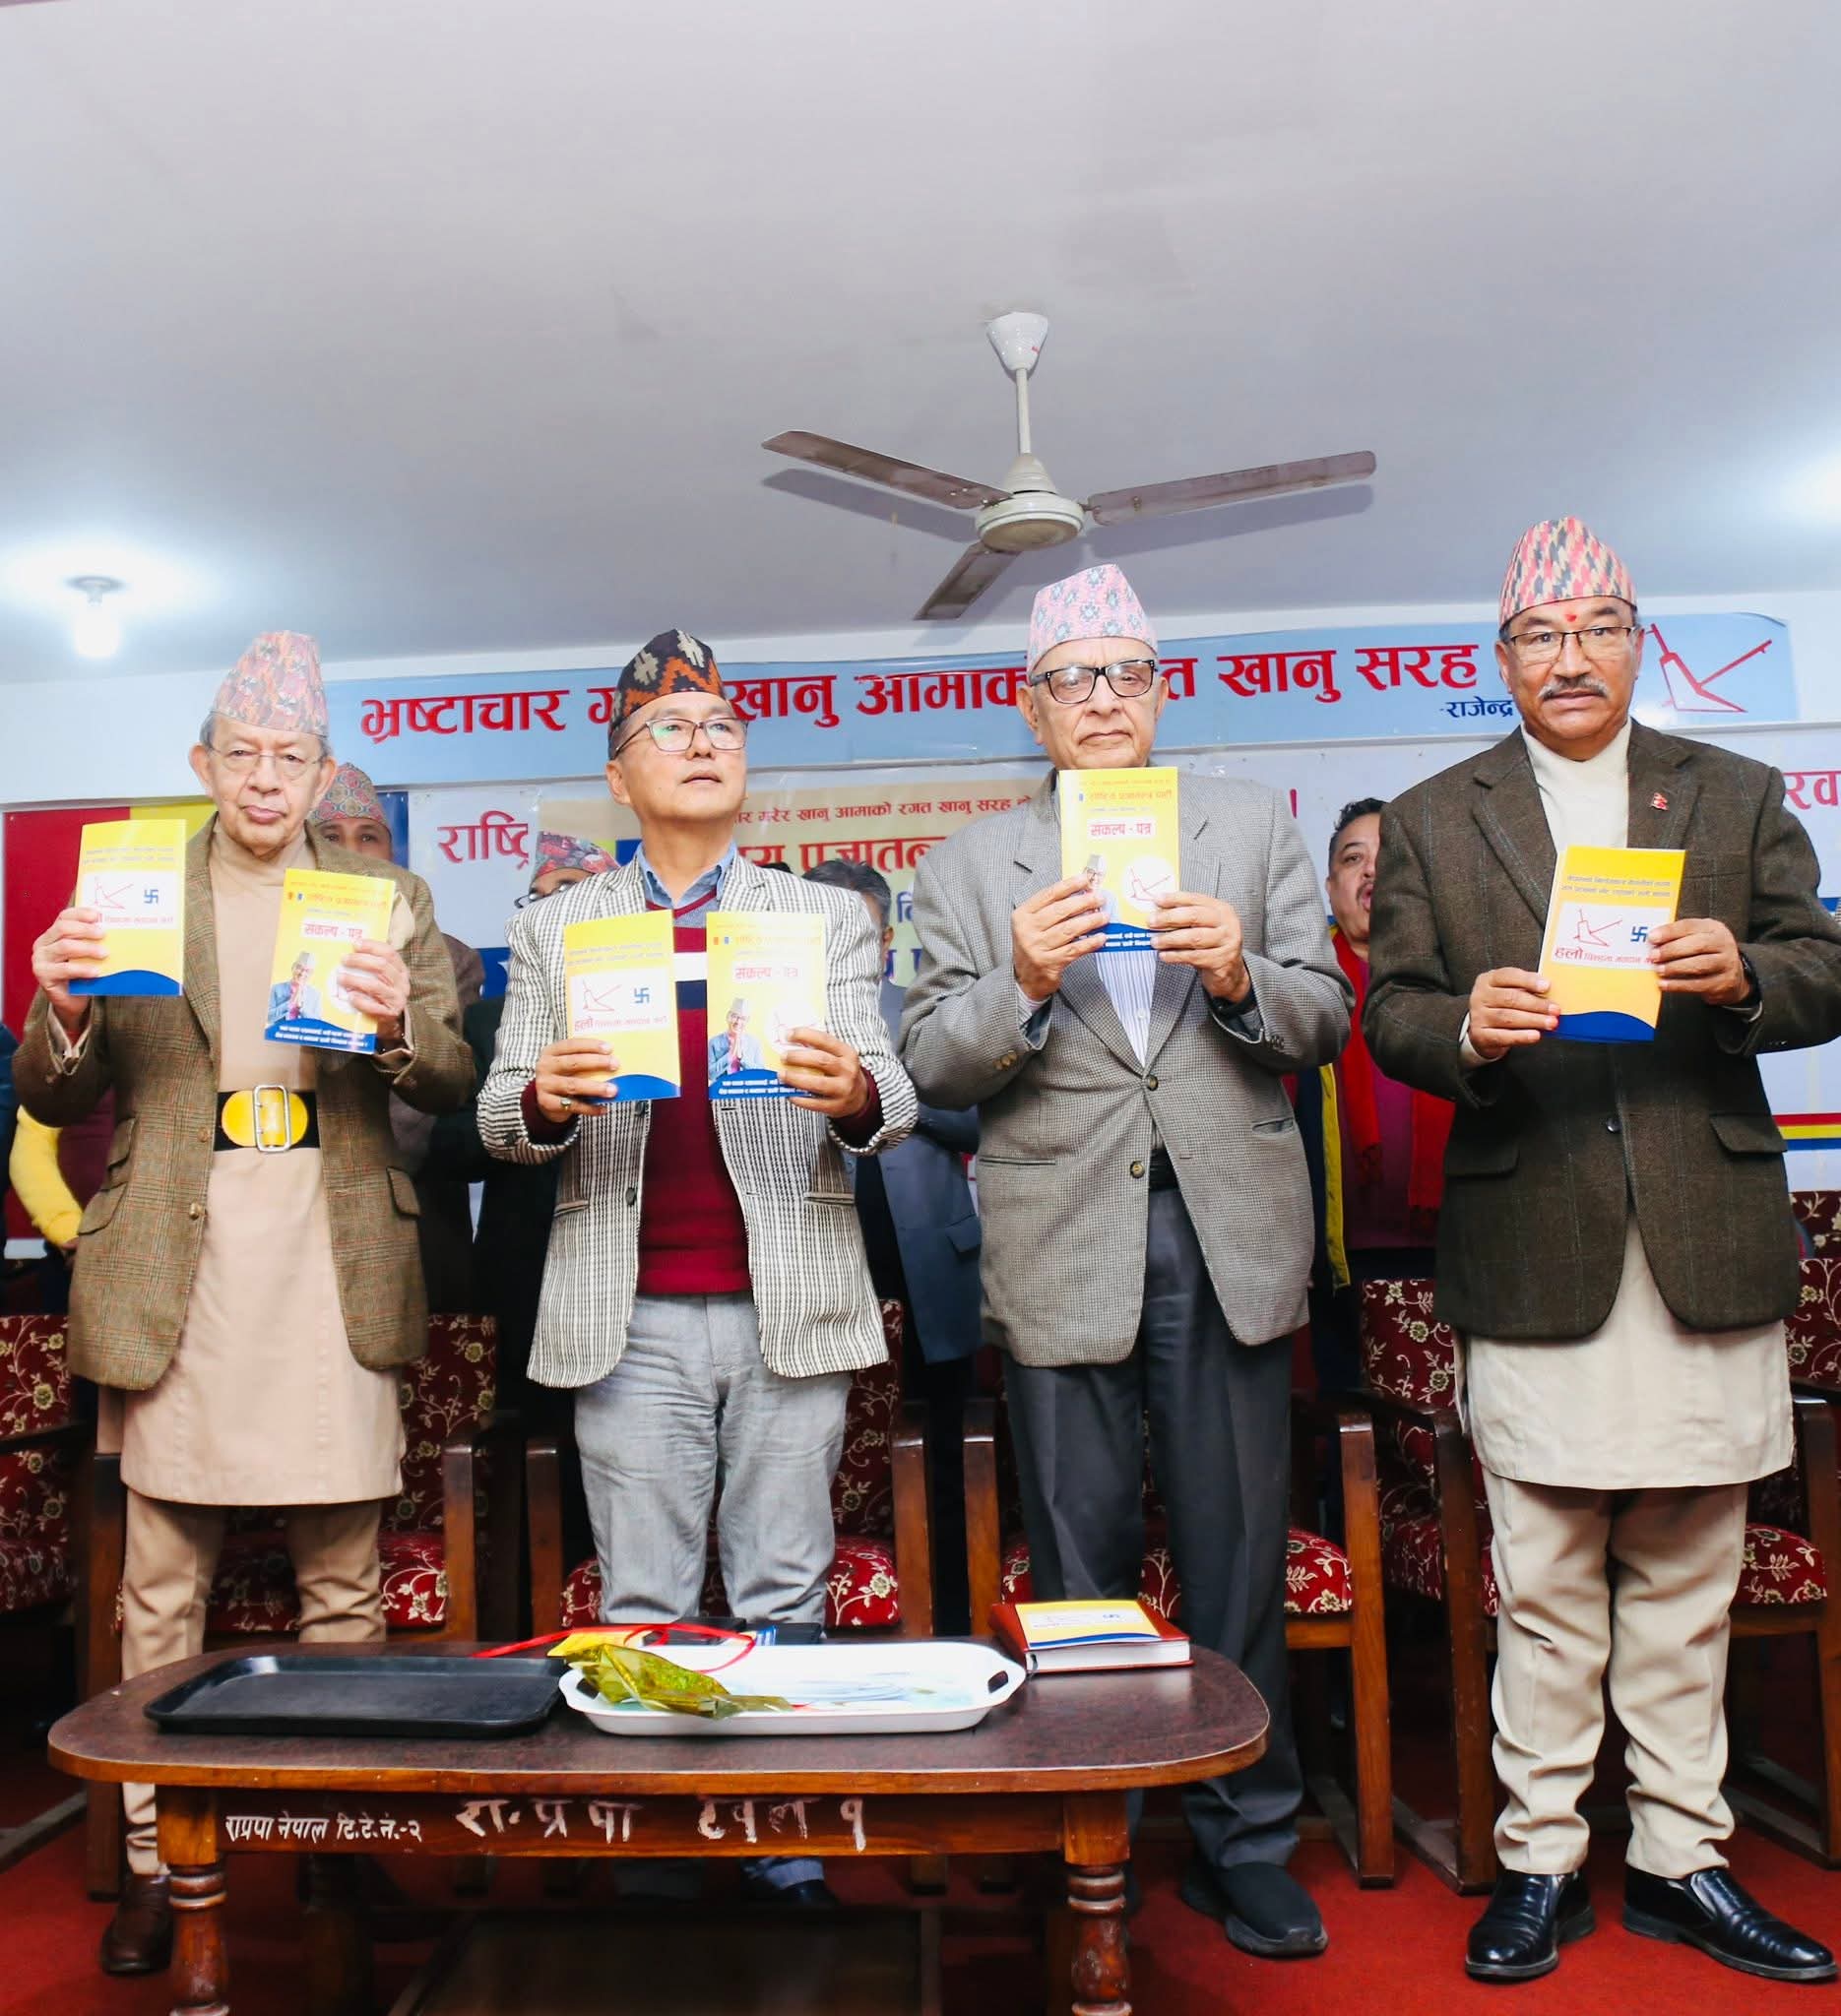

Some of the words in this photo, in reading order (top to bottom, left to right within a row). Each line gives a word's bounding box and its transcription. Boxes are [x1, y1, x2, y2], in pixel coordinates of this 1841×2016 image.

[361, 689, 570, 745] भ्रष्टाचार
[1217, 650, 1341, 704] खानु
[1355, 644, 1479, 691] सरह
[278, 1810, 330, 1844] नेपाल
